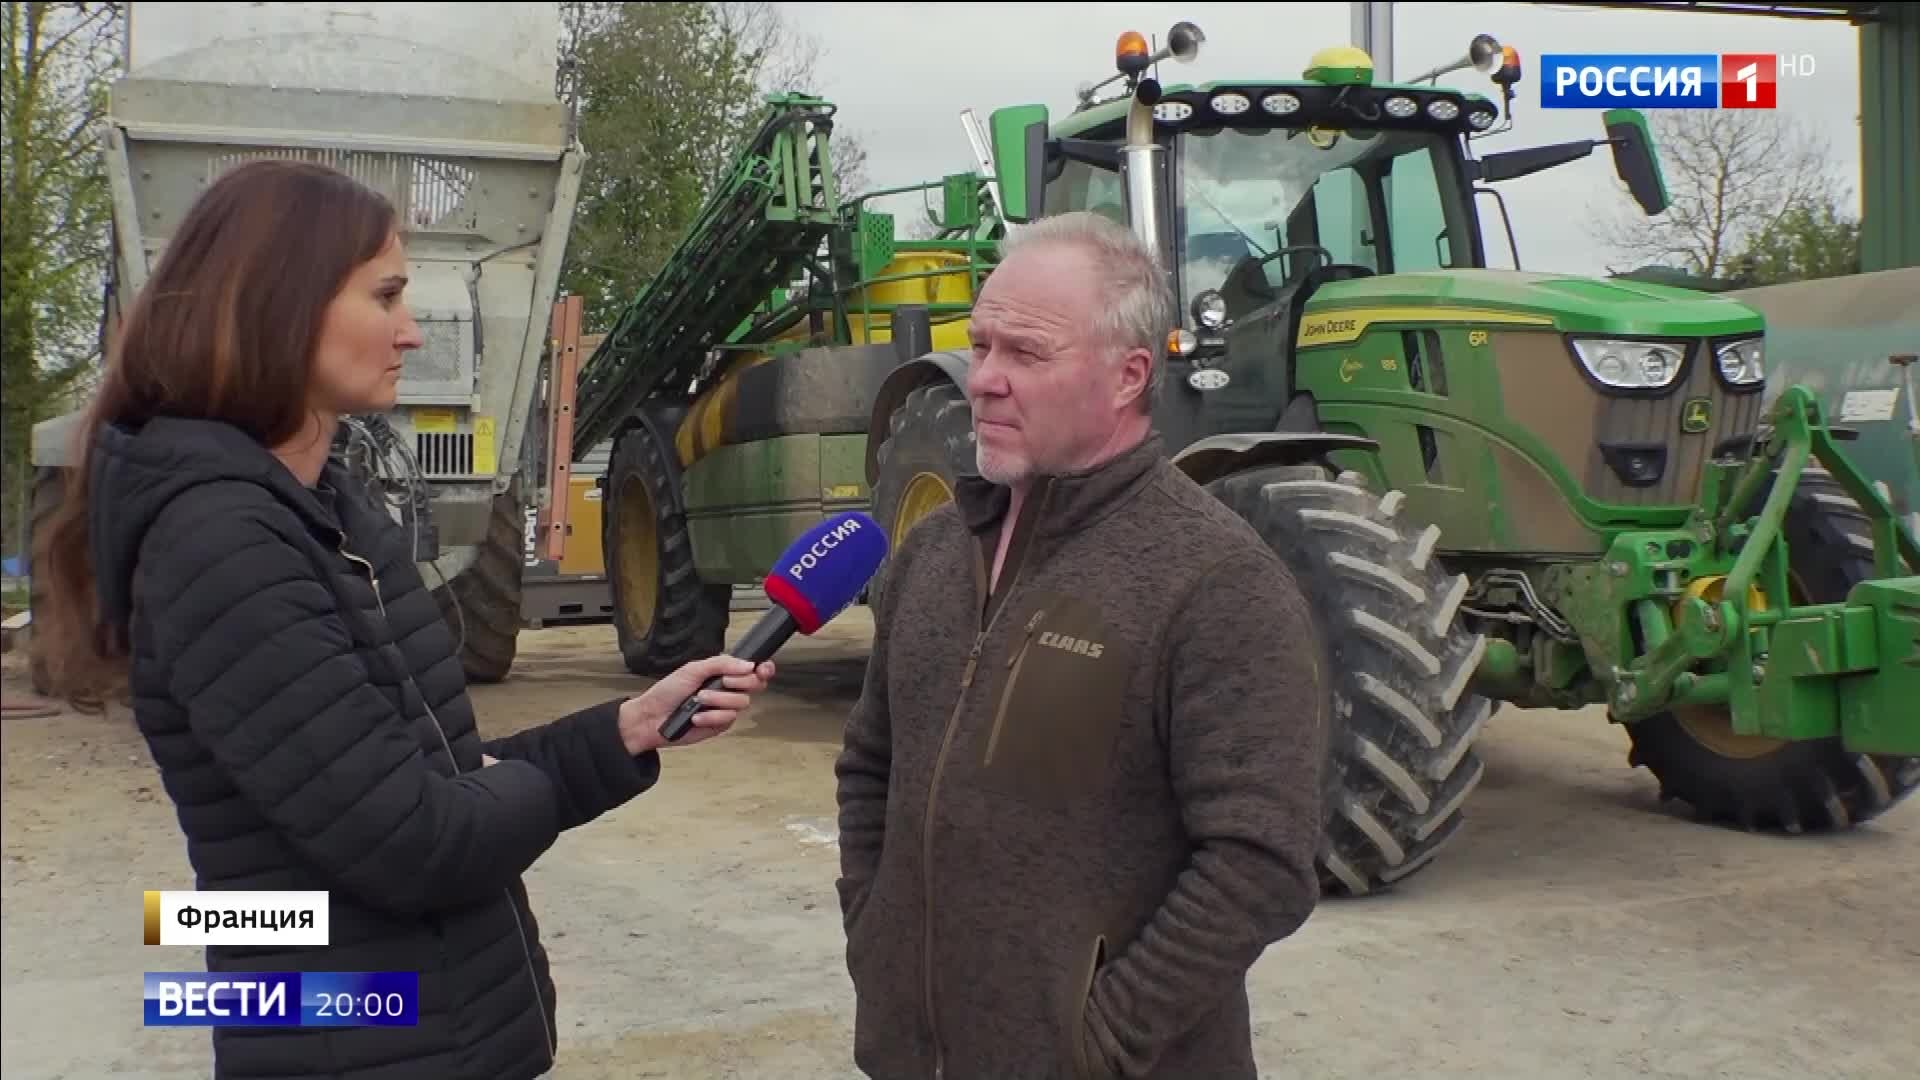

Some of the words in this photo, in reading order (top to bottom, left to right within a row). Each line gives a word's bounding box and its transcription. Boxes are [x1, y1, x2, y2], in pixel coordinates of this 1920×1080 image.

[1304, 323, 1327, 336] JOHN
[1327, 319, 1356, 333] DEERE
[789, 519, 862, 580] РОССИЯ
[1038, 631, 1104, 658] CLAAS
